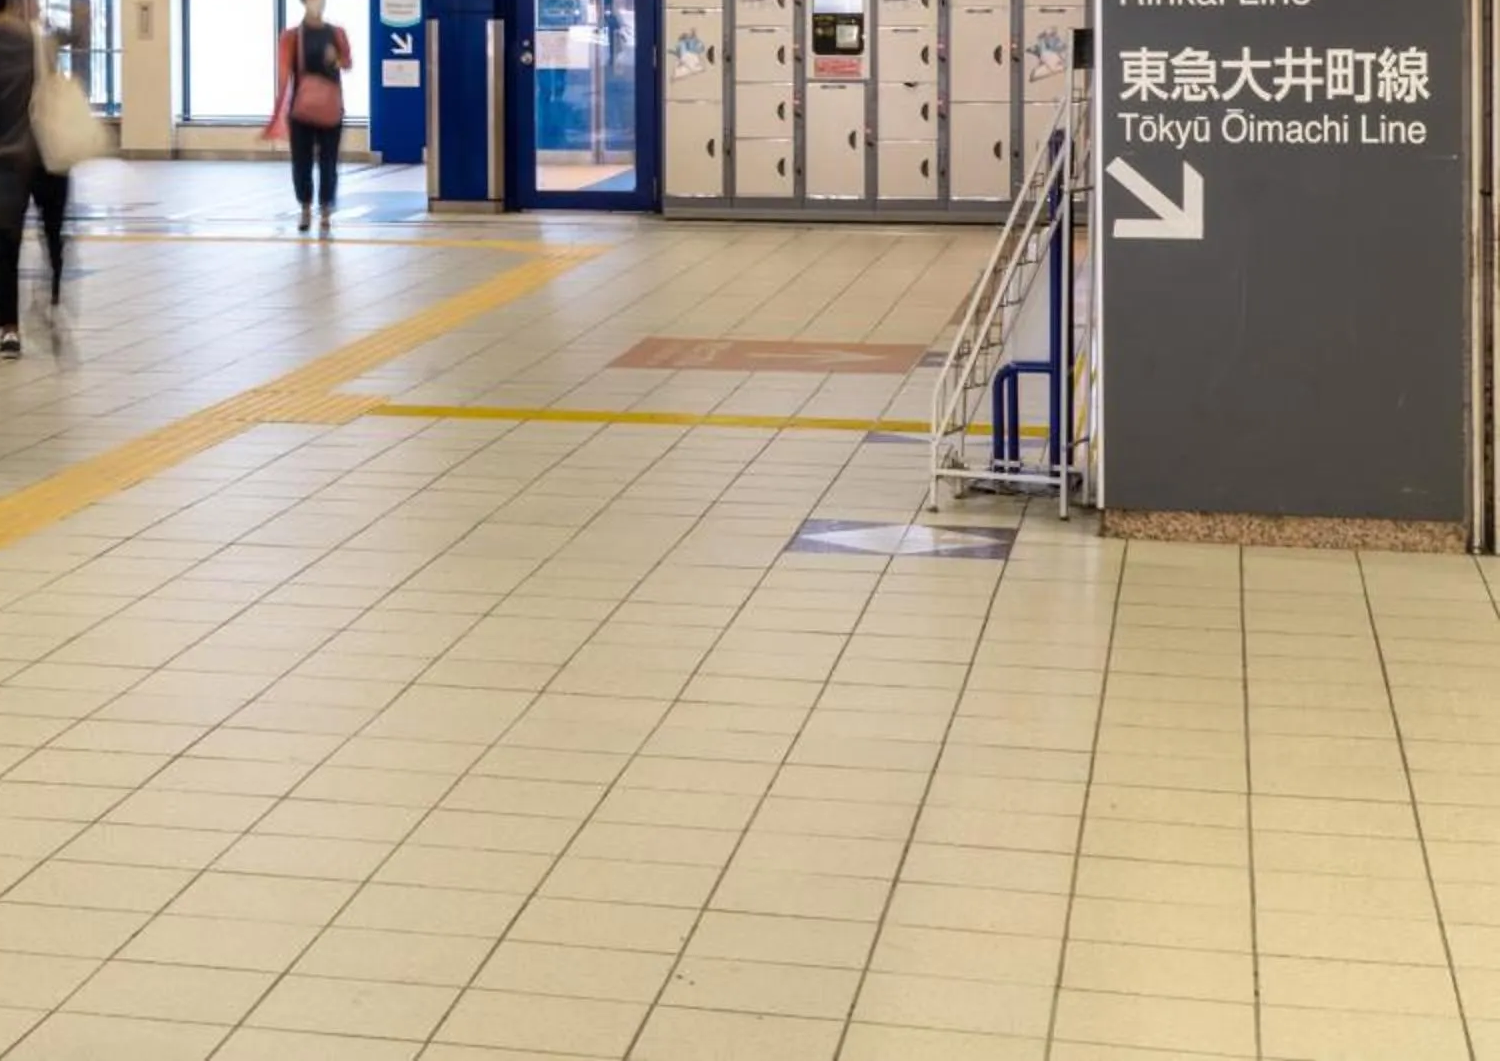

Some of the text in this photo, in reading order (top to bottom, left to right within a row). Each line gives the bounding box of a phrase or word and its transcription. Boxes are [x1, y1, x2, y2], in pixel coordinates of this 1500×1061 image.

[1119, 46, 1431, 104] 東急大井町線
[1118, 109, 1427, 149] Tōkyū Ōimachi Line
